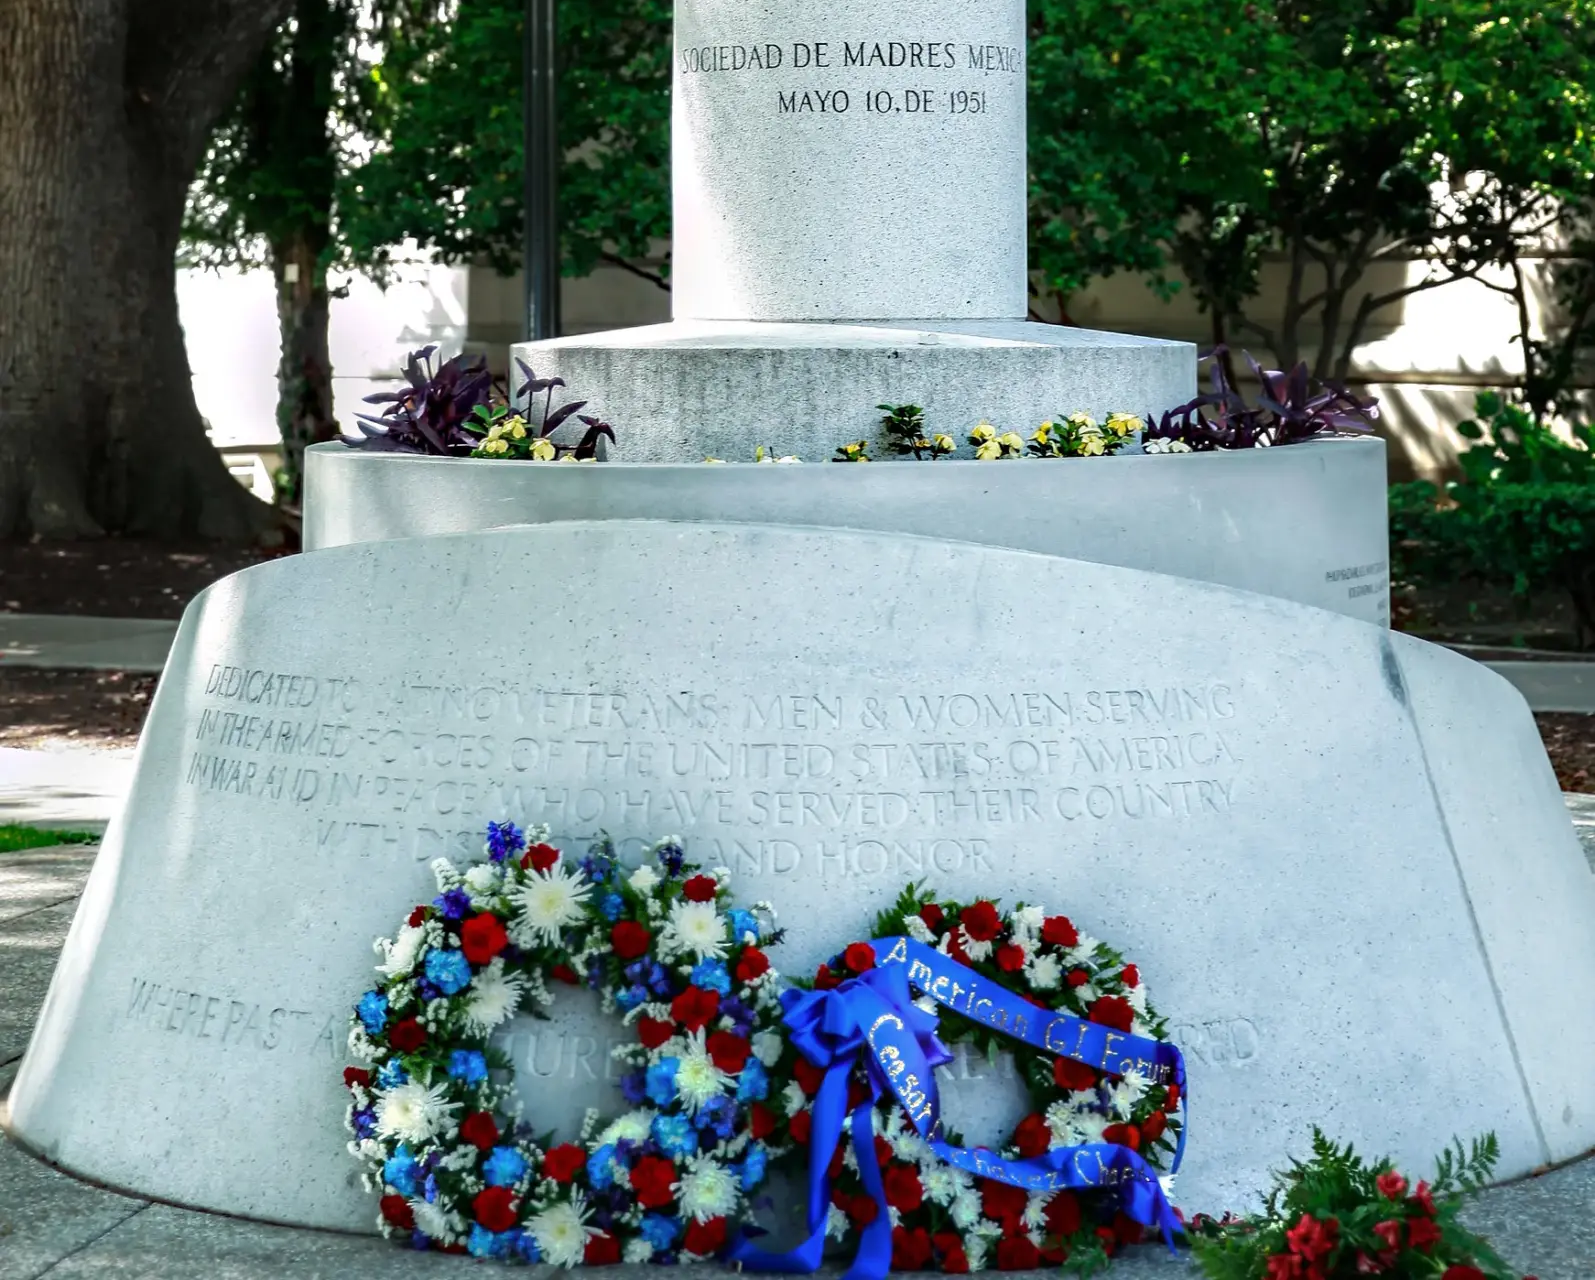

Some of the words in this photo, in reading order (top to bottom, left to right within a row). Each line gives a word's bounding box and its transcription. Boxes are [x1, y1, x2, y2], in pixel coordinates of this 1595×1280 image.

[683, 43, 782, 73] SOCIEDAD
[793, 42, 830, 68] DE
[842, 42, 956, 68] MADRES
[779, 90, 849, 114] MAYO
[949, 91, 987, 115] 1951
[205, 663, 319, 708] DEDICATED
[325, 674, 363, 714] TO
[744, 693, 843, 730] MEN
[857, 695, 889, 730] &
[898, 692, 1075, 729] WOMEN
[1085, 684, 1236, 726] SERVING
[195, 708, 221, 740] IN
[219, 712, 260, 748] THE
[255, 718, 353, 758] ARMED
[365, 727, 496, 770] FORCES
[510, 736, 566, 774] OF
[574, 739, 654, 777] THE
[667, 742, 836, 778] UNITED
[849, 741, 993, 779] STATES
[1008, 738, 1060, 775] OF
[187, 752, 212, 784] IN
[210, 757, 258, 795] WAR
[258, 765, 319, 804] AND
[326, 771, 364, 807] IN
[493, 784, 607, 823] WHO
[619, 788, 735, 826] HAVE
[747, 789, 911, 827] SERVED
[919, 788, 1045, 826] THEIR
[1056, 779, 1236, 821] COUNTRY
[704, 836, 801, 876] AND
[817, 838, 998, 877] HONOR
[126, 975, 221, 1038] WHERE
[221, 998, 313, 1056] PAST
[882, 937, 1029, 1039] American
[1045, 1018, 1091, 1060] GI
[868, 1013, 933, 1122] Ceasar
